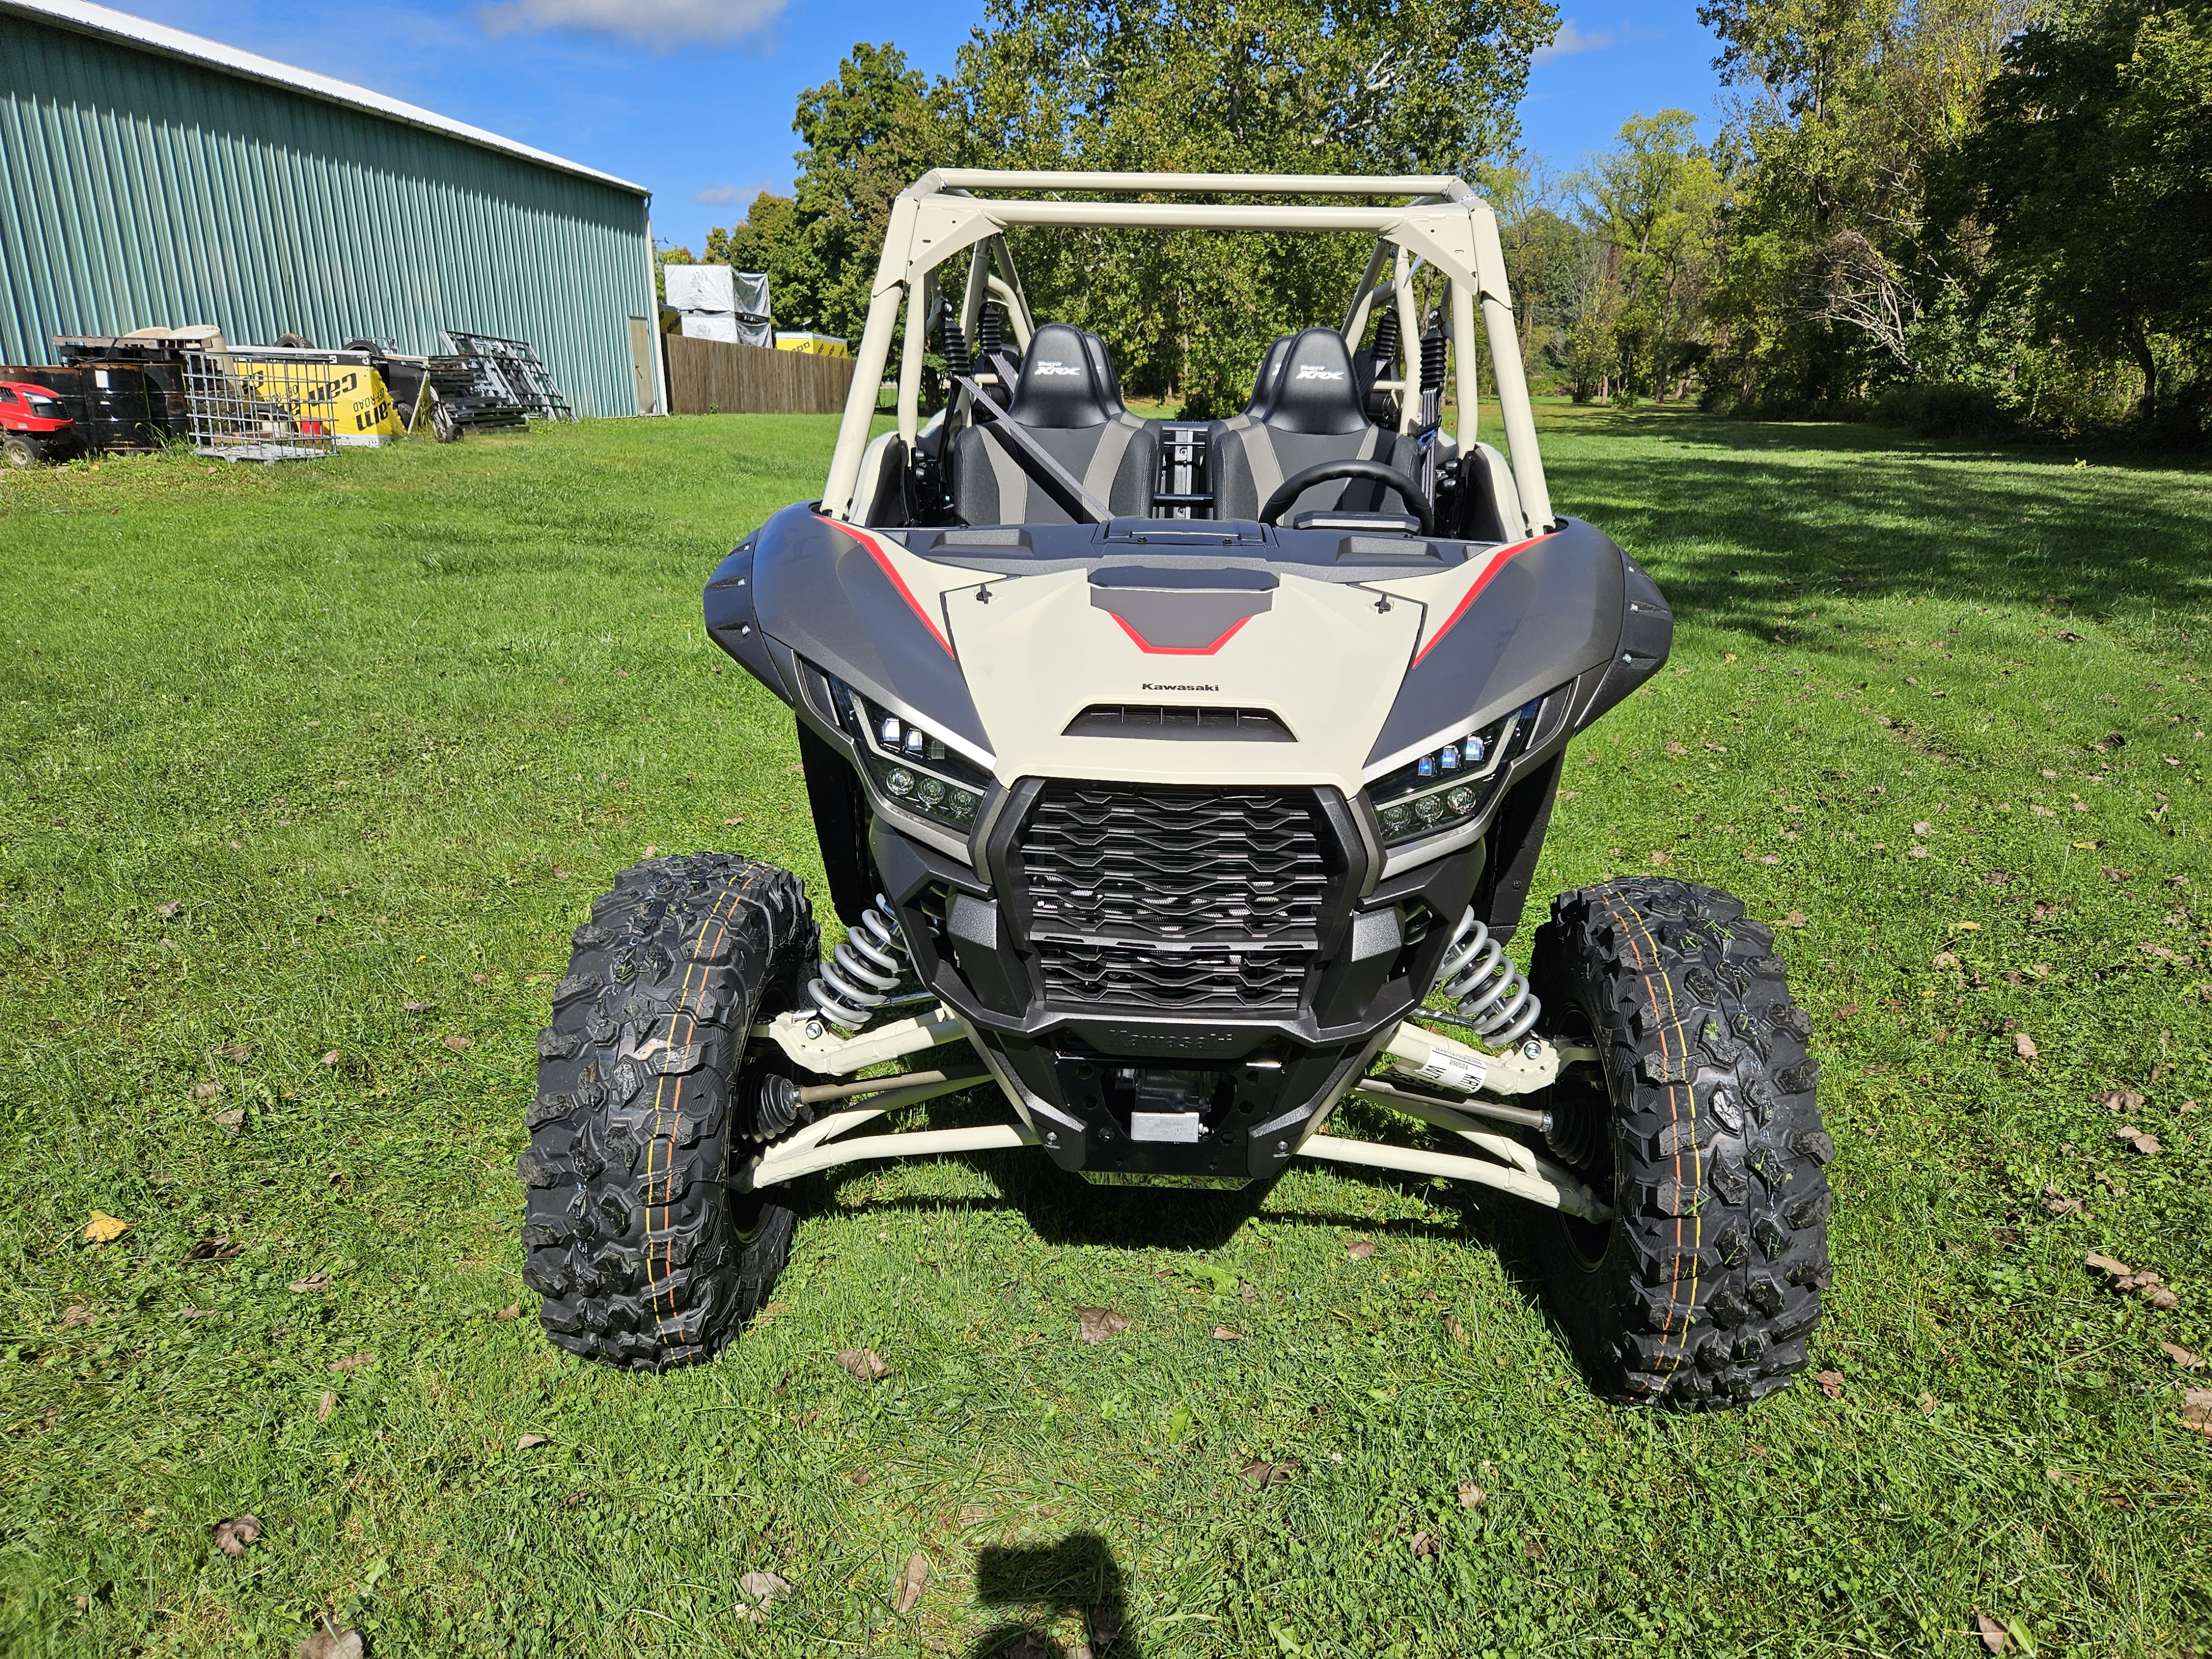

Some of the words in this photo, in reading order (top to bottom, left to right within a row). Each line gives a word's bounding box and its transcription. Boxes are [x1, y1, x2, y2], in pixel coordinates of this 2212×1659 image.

[1034, 367, 1081, 375] KRX
[1296, 371, 1344, 379] KRX
[1142, 683, 1219, 691] Kawasaki
[1108, 1029, 1233, 1050] Kawasaki
[1449, 1059, 1468, 1070] 090524
